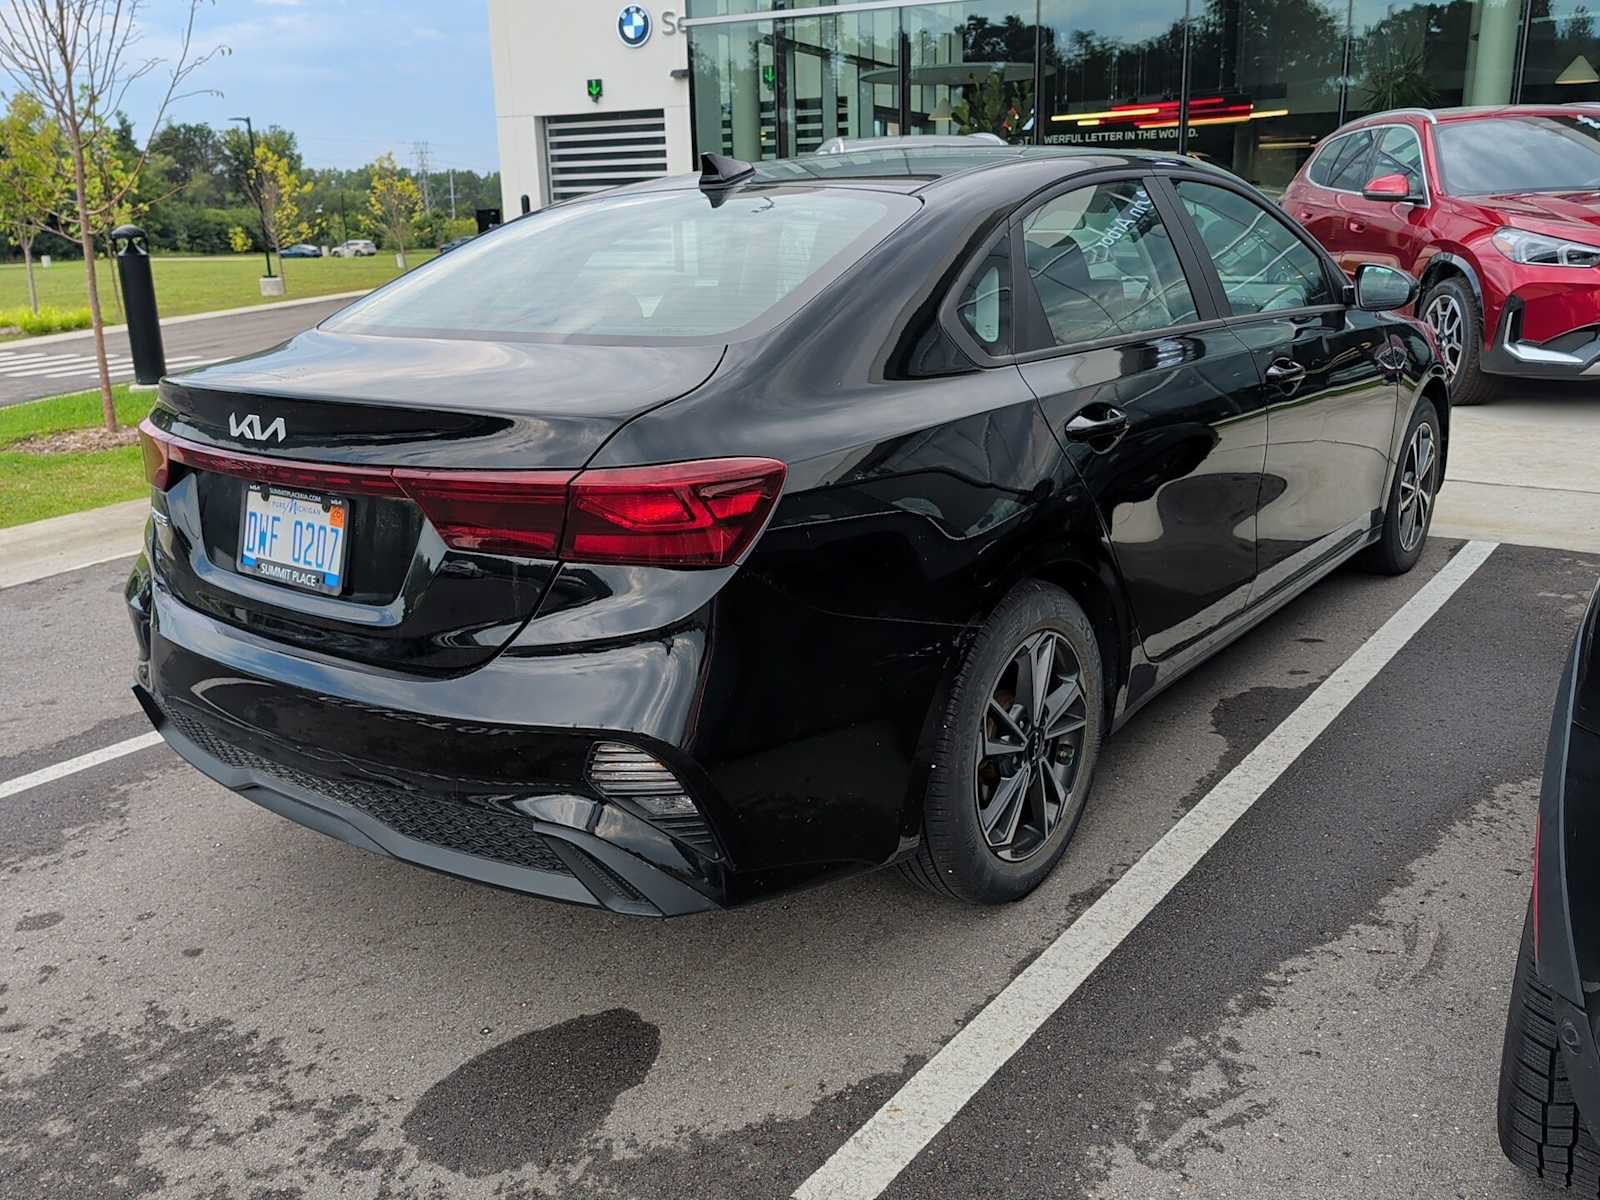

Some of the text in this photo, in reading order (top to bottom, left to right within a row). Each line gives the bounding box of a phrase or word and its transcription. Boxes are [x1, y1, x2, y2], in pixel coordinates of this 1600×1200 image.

[1085, 132, 1122, 143] LETTER
[1125, 131, 1136, 141] IN
[1137, 130, 1157, 140] THE
[229, 412, 287, 443] KIA
[246, 511, 339, 571] DWF 0207
[260, 563, 317, 587] SUMMIT PLACE
